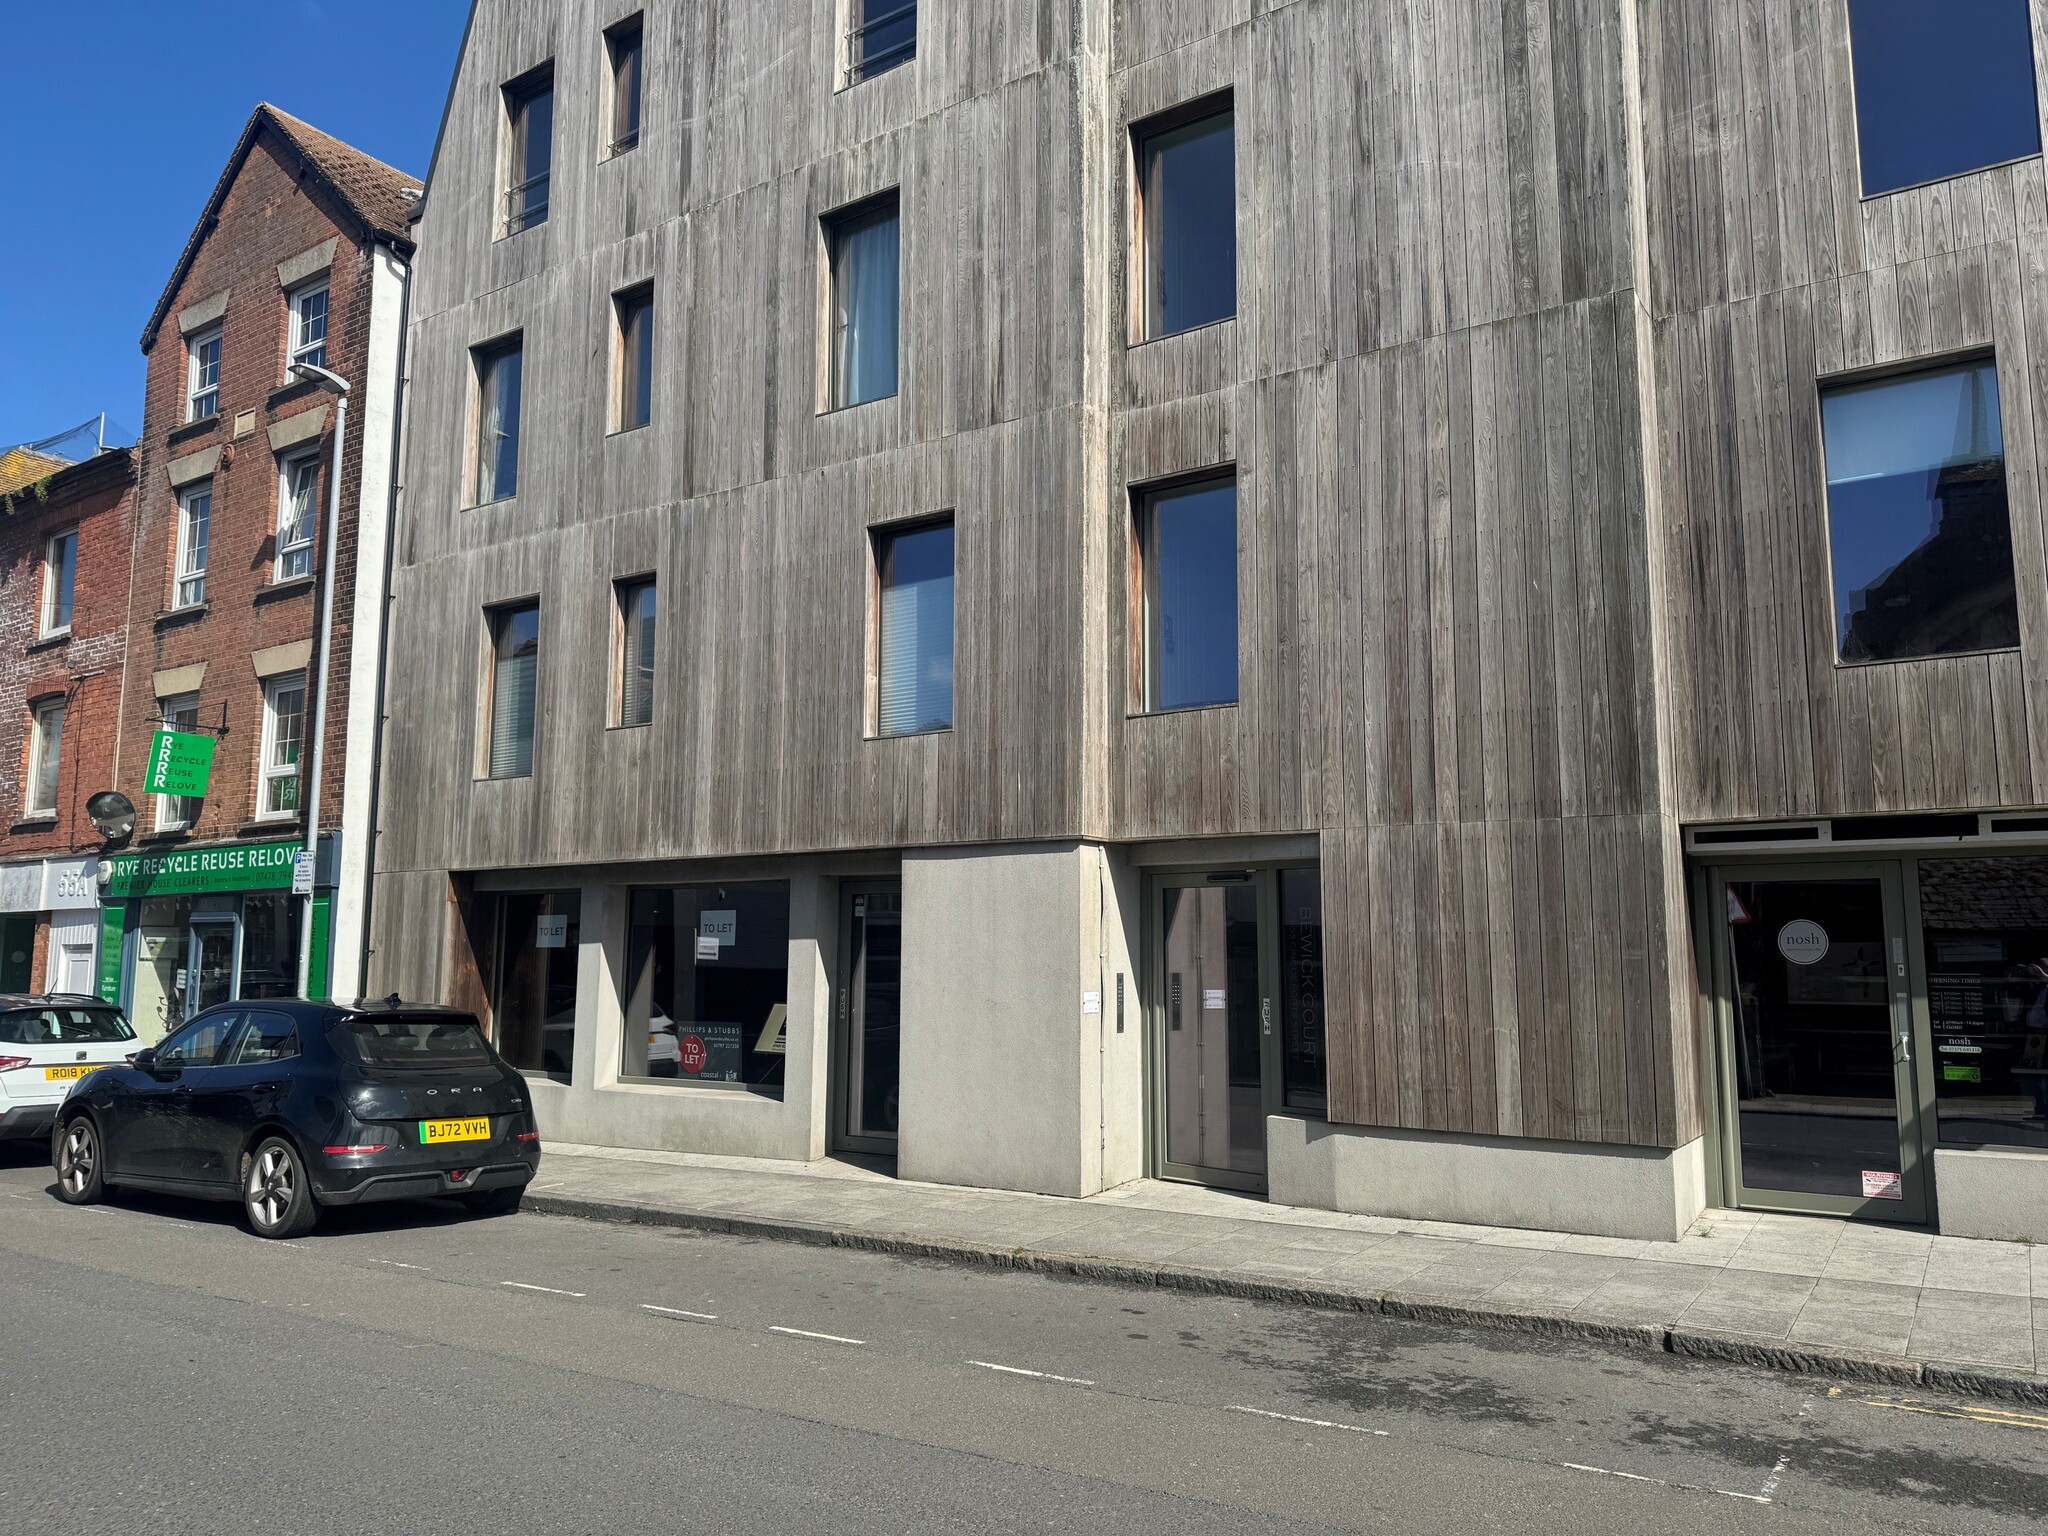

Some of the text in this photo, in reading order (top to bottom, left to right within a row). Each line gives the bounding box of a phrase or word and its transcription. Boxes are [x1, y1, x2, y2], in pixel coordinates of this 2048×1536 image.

[158, 748, 207, 766] RECYCLE
[156, 761, 193, 777] REUSE
[153, 774, 197, 791] RELOVE
[117, 847, 304, 877] RYE RECYCLE REUSE RELOV
[58, 869, 88, 897] 55A
[149, 878, 171, 889] HOUSE
[173, 876, 209, 887] CLEARERS
[540, 926, 564, 936] TO LET
[704, 923, 734, 933] TO LET
[1786, 932, 1820, 945] nosh
[1299, 906, 1317, 1069] BEWICK COURT
[1948, 1037, 1971, 1045] nosh
[686, 1043, 699, 1054] TO
[685, 1054, 700, 1065] LET
[429, 1123, 487, 1138] BJ72 VVH
